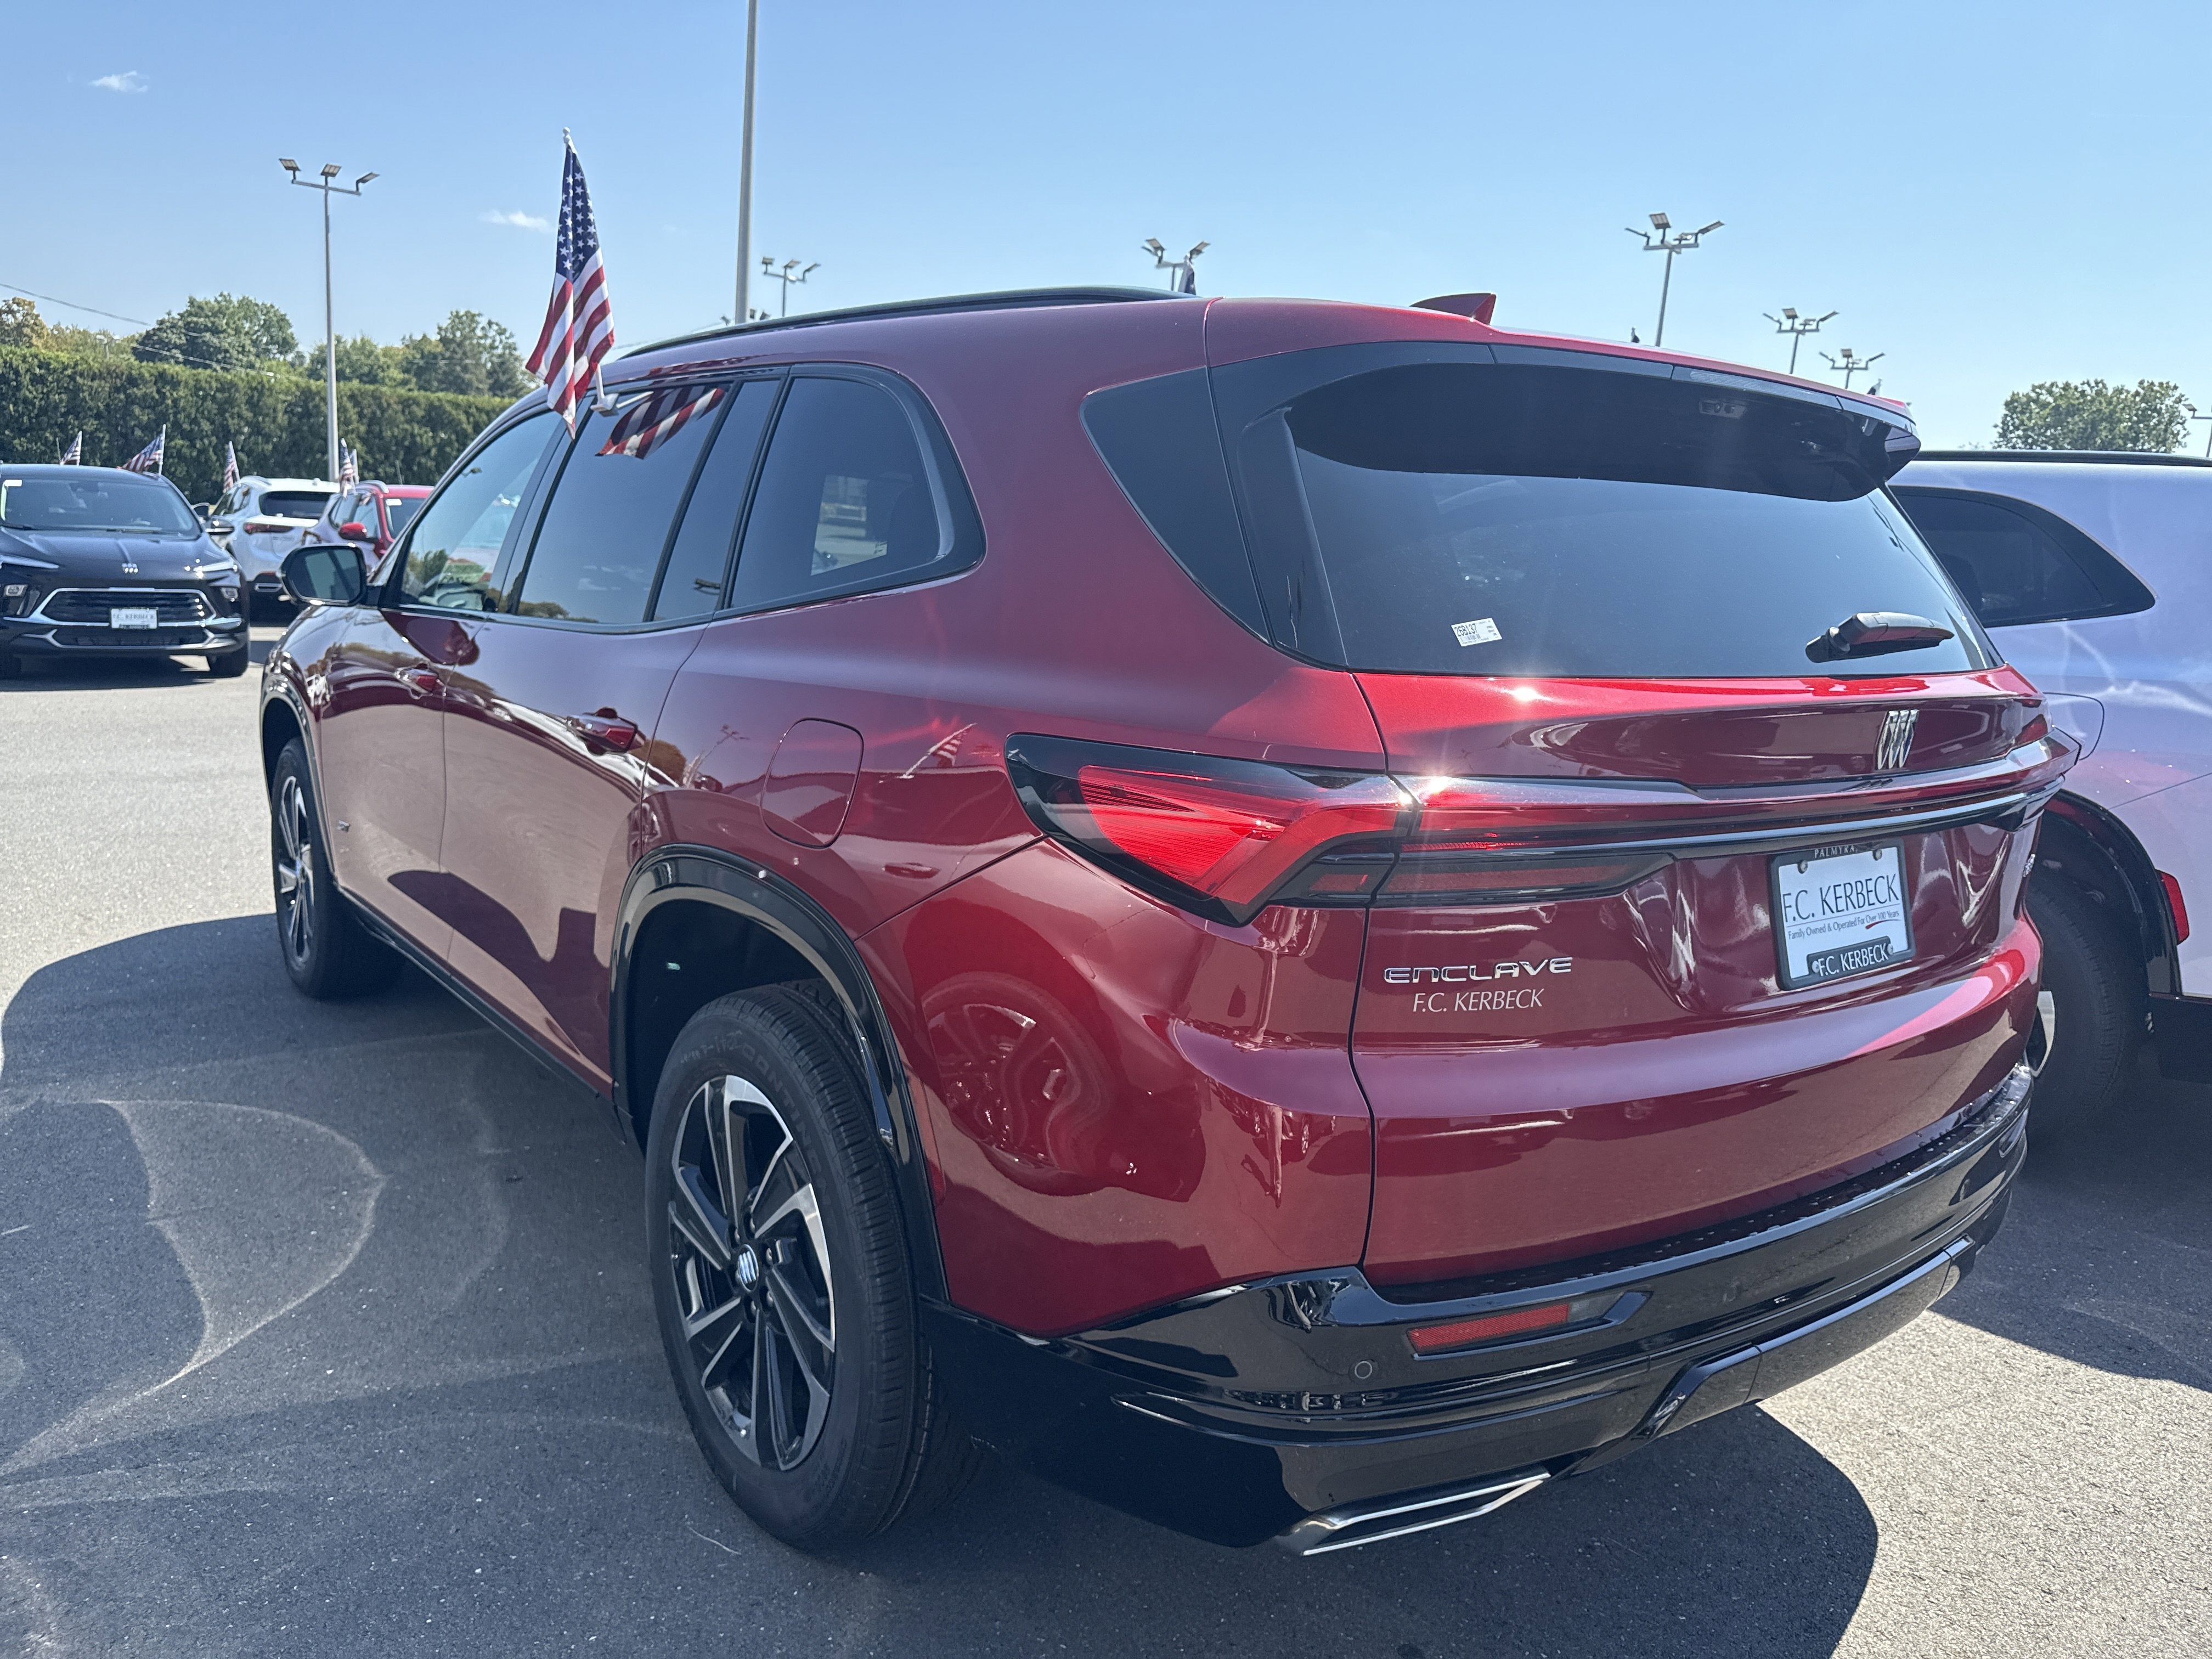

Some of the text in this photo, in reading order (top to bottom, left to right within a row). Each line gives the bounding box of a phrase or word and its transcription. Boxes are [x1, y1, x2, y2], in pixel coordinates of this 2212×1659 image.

[1454, 623, 1478, 637] 26B137
[1782, 873, 1899, 923] F.C. KERBECK
[1788, 928, 1805, 940] Family
[1806, 924, 1826, 936] Owned
[1827, 923, 1832, 932] &
[1832, 919, 1858, 932] Operated
[1865, 914, 1877, 924] Over
[1877, 912, 1886, 921] 100
[1887, 910, 1899, 918] Years
[1383, 956, 1573, 984] ENCLAVE
[1818, 943, 1889, 977] F.C. KERBECK
[1413, 988, 1545, 1013] F.C. KERBECK
